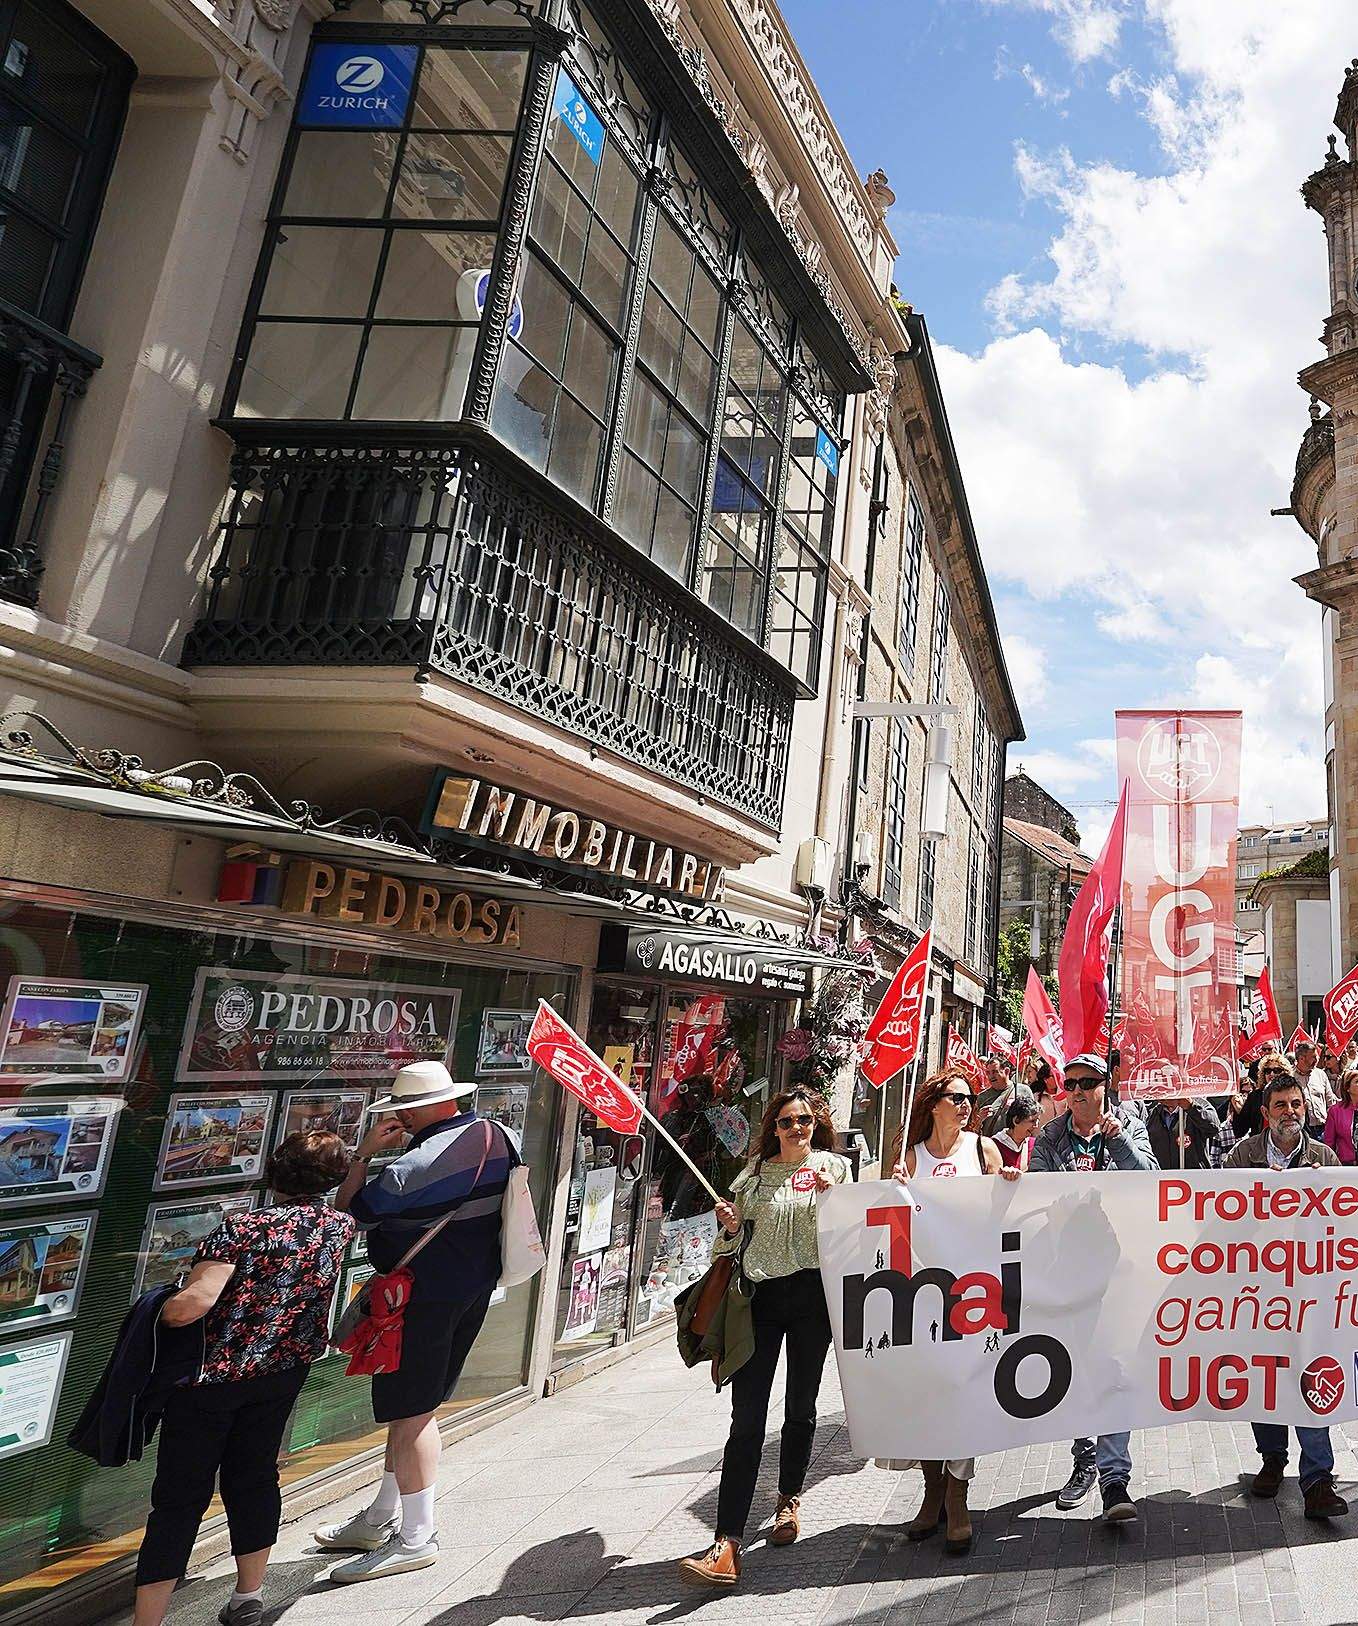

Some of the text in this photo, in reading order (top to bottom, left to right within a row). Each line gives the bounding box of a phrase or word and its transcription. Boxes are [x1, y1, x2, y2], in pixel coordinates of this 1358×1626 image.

[317, 96, 389, 109] ZURICH
[1149, 730, 1209, 765] UGT
[458, 778, 727, 903] INMOBILIARIA
[302, 861, 522, 949] PEDROSA
[1149, 804, 1215, 1055] UGT
[658, 941, 758, 985] AGASALLO
[254, 990, 439, 1037] PEDROSA
[250, 1033, 438, 1047] AGENCIA INMOBILIARIA
[277, 1056, 324, 1067] 986 86 66 18
[1154, 1284, 1318, 1348] gañar
[1157, 1354, 1291, 1413] UGT
